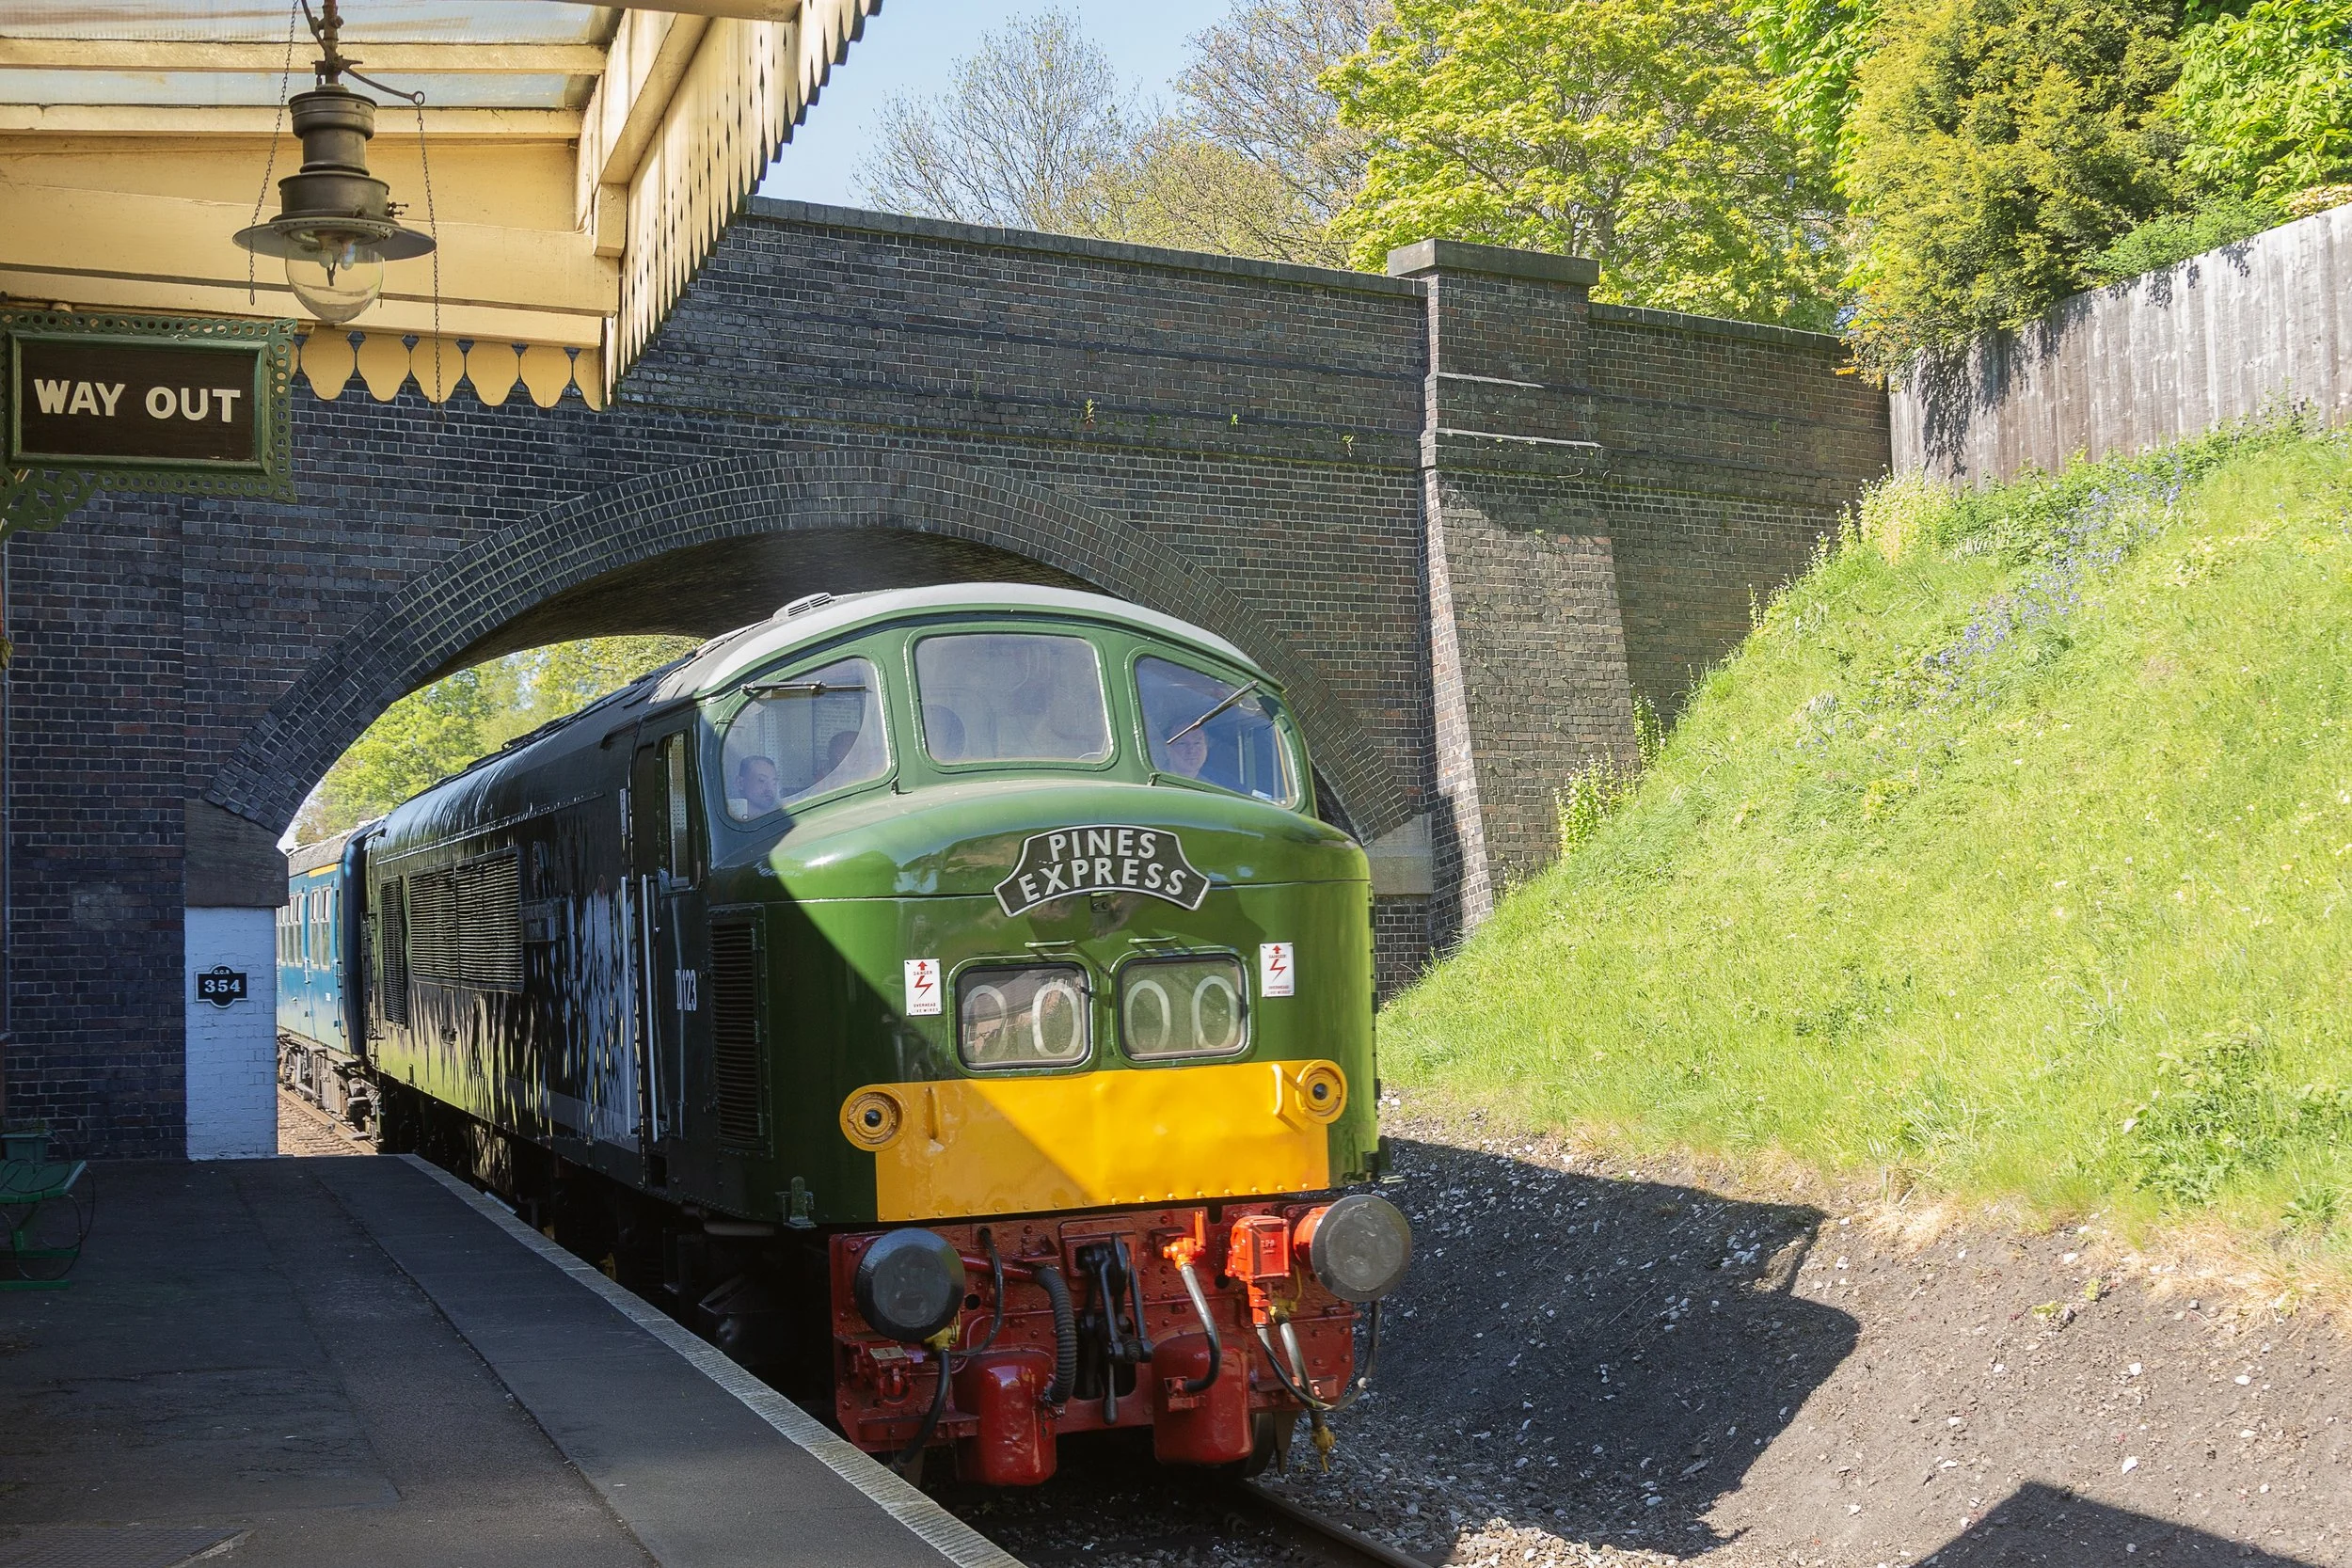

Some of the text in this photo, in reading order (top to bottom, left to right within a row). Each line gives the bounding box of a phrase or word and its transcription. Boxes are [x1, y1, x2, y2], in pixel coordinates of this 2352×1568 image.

[34, 378, 241, 423] WAY OUT
[1048, 829, 1157, 863] PINES
[1018, 857, 1187, 903] EXPRESS
[204, 979, 241, 992] 354
[675, 969, 697, 1011] D123
